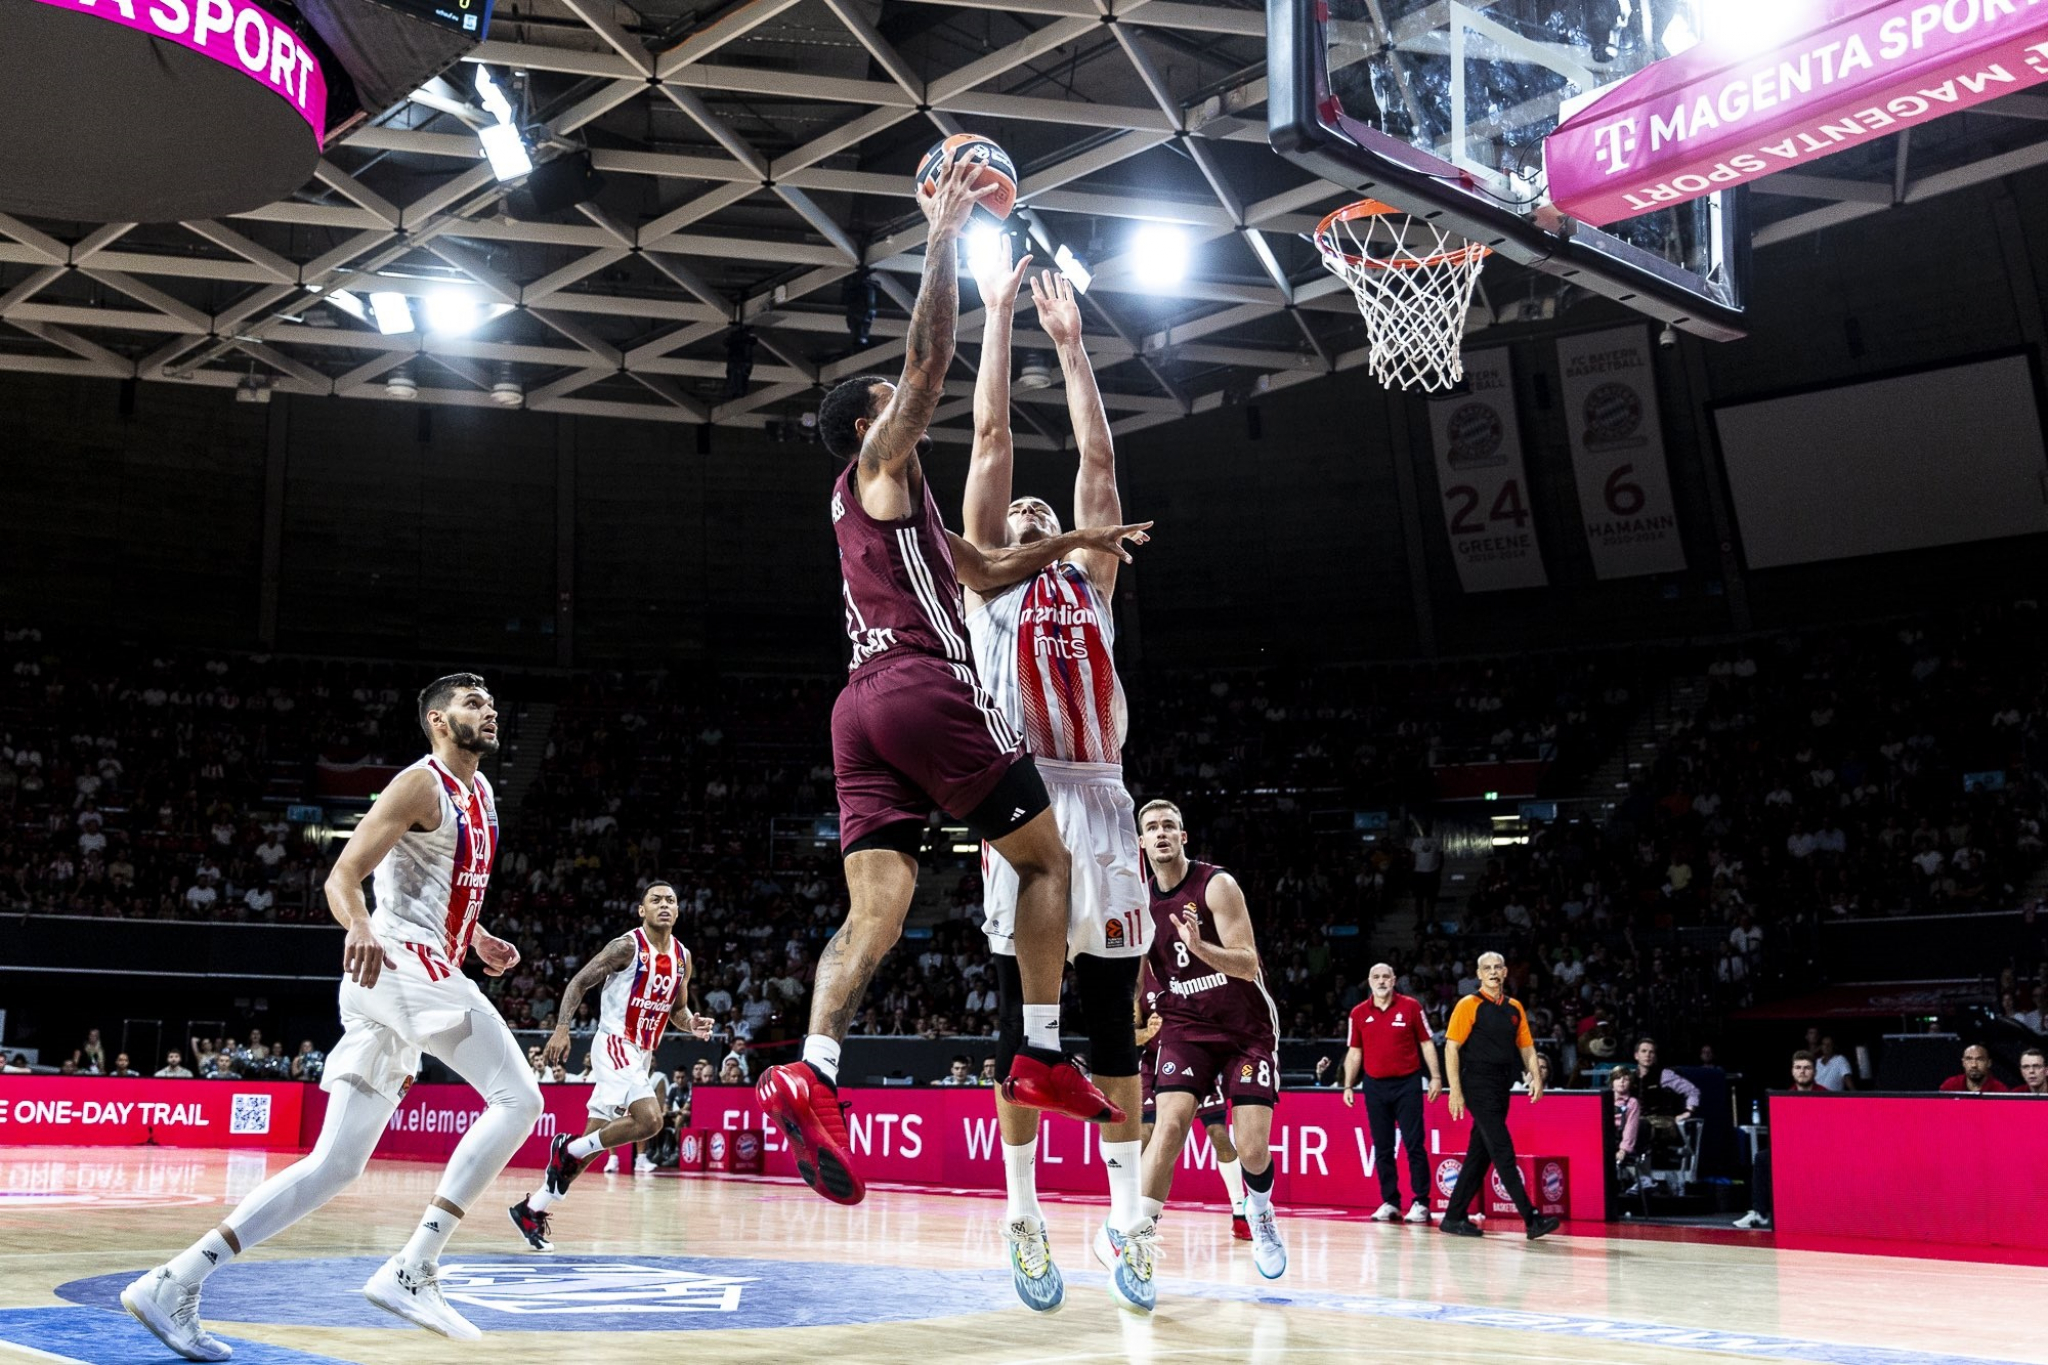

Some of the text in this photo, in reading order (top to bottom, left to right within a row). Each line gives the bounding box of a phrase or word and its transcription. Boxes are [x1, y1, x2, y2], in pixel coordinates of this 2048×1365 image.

[149, 0, 314, 109] SPORT
[1650, 33, 1874, 152] MAGENTA
[1758, 63, 2016, 159] MAGENTA
[1622, 154, 1767, 211] SPORT
[1566, 358, 1645, 378] BASKETBALL
[1605, 463, 1645, 516] 6
[1444, 479, 1529, 535] 24
[1588, 516, 1674, 537] HAMANN
[1458, 535, 1531, 554] GREENE
[1020, 603, 1098, 626] meridian
[1033, 633, 1089, 660] mts
[1124, 909, 1142, 948] 11
[1173, 941, 1190, 968] 8
[653, 974, 672, 995] 99
[637, 1015, 660, 1031] mts
[1257, 1060, 1271, 1087] 8
[14, 1100, 135, 1125] ONE-DAY
[137, 1102, 210, 1126] TRAIL
[1446, 1312, 1821, 1350] BMW
